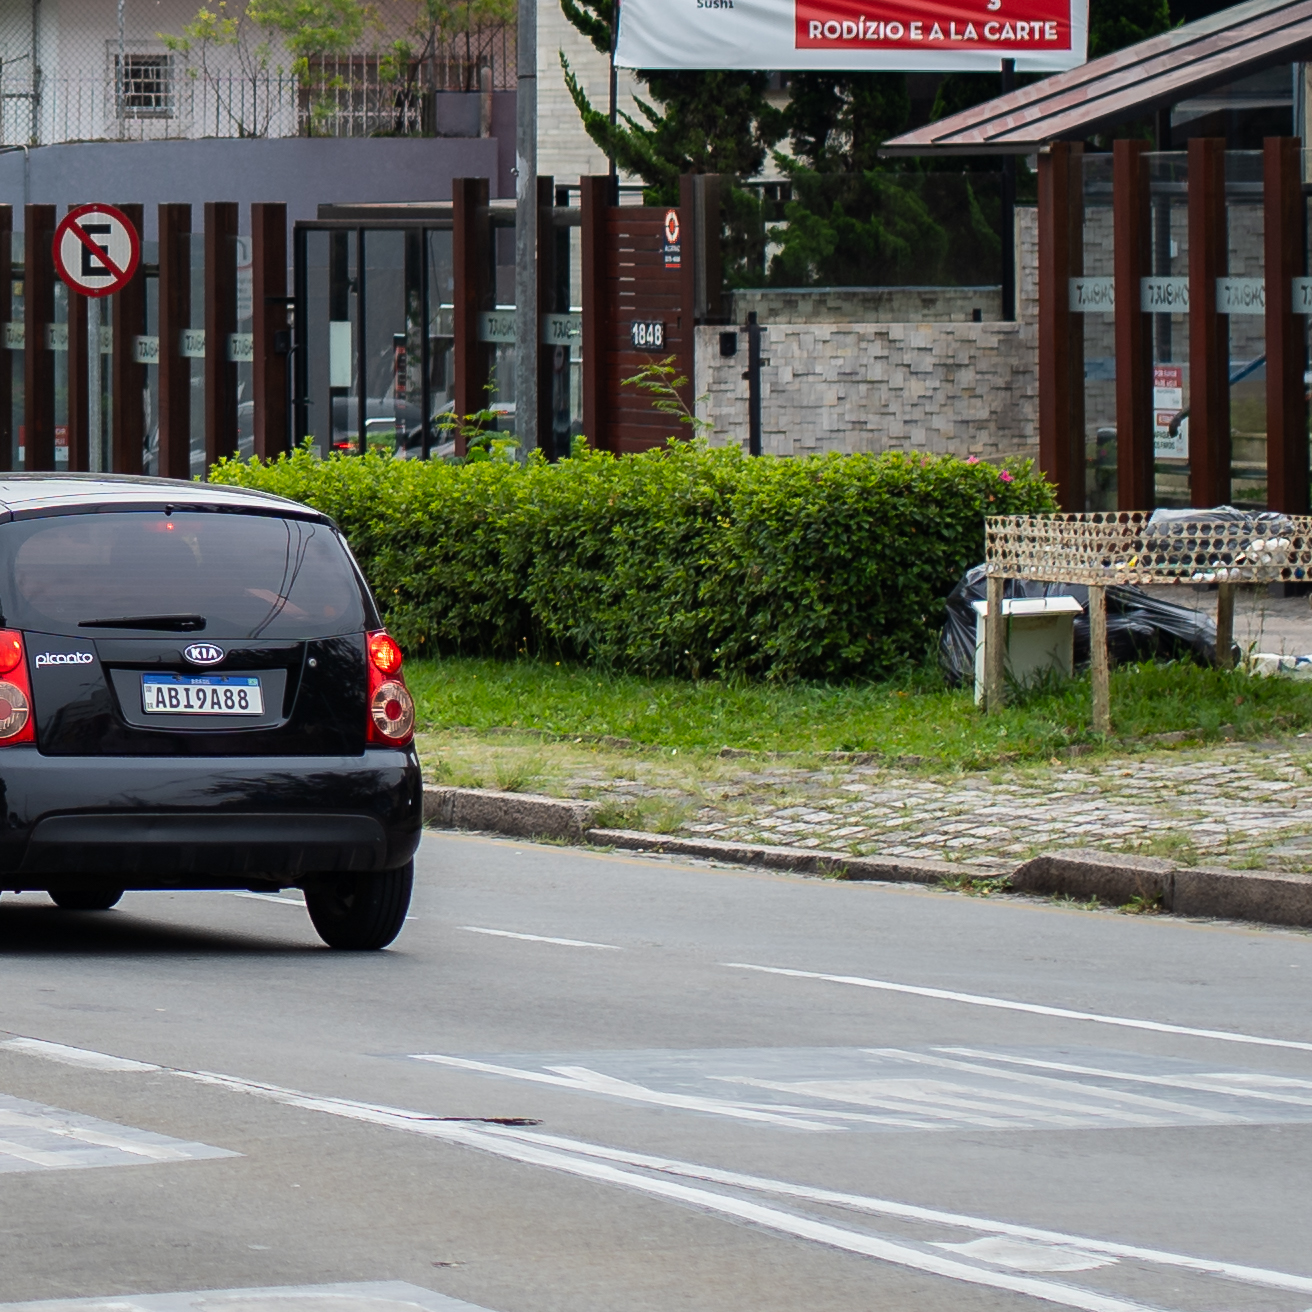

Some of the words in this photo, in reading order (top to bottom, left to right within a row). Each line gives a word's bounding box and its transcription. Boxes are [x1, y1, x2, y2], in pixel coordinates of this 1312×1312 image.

[808, 15, 904, 40] RODÍZIO
[909, 21, 924, 40] E
[928, 21, 945, 41] A
[950, 21, 979, 41] LA
[983, 21, 1058, 41] CARTE
[81, 223, 112, 277] E
[632, 323, 662, 346] 1848
[35, 651, 94, 669] picanto
[190, 647, 218, 659] KIA
